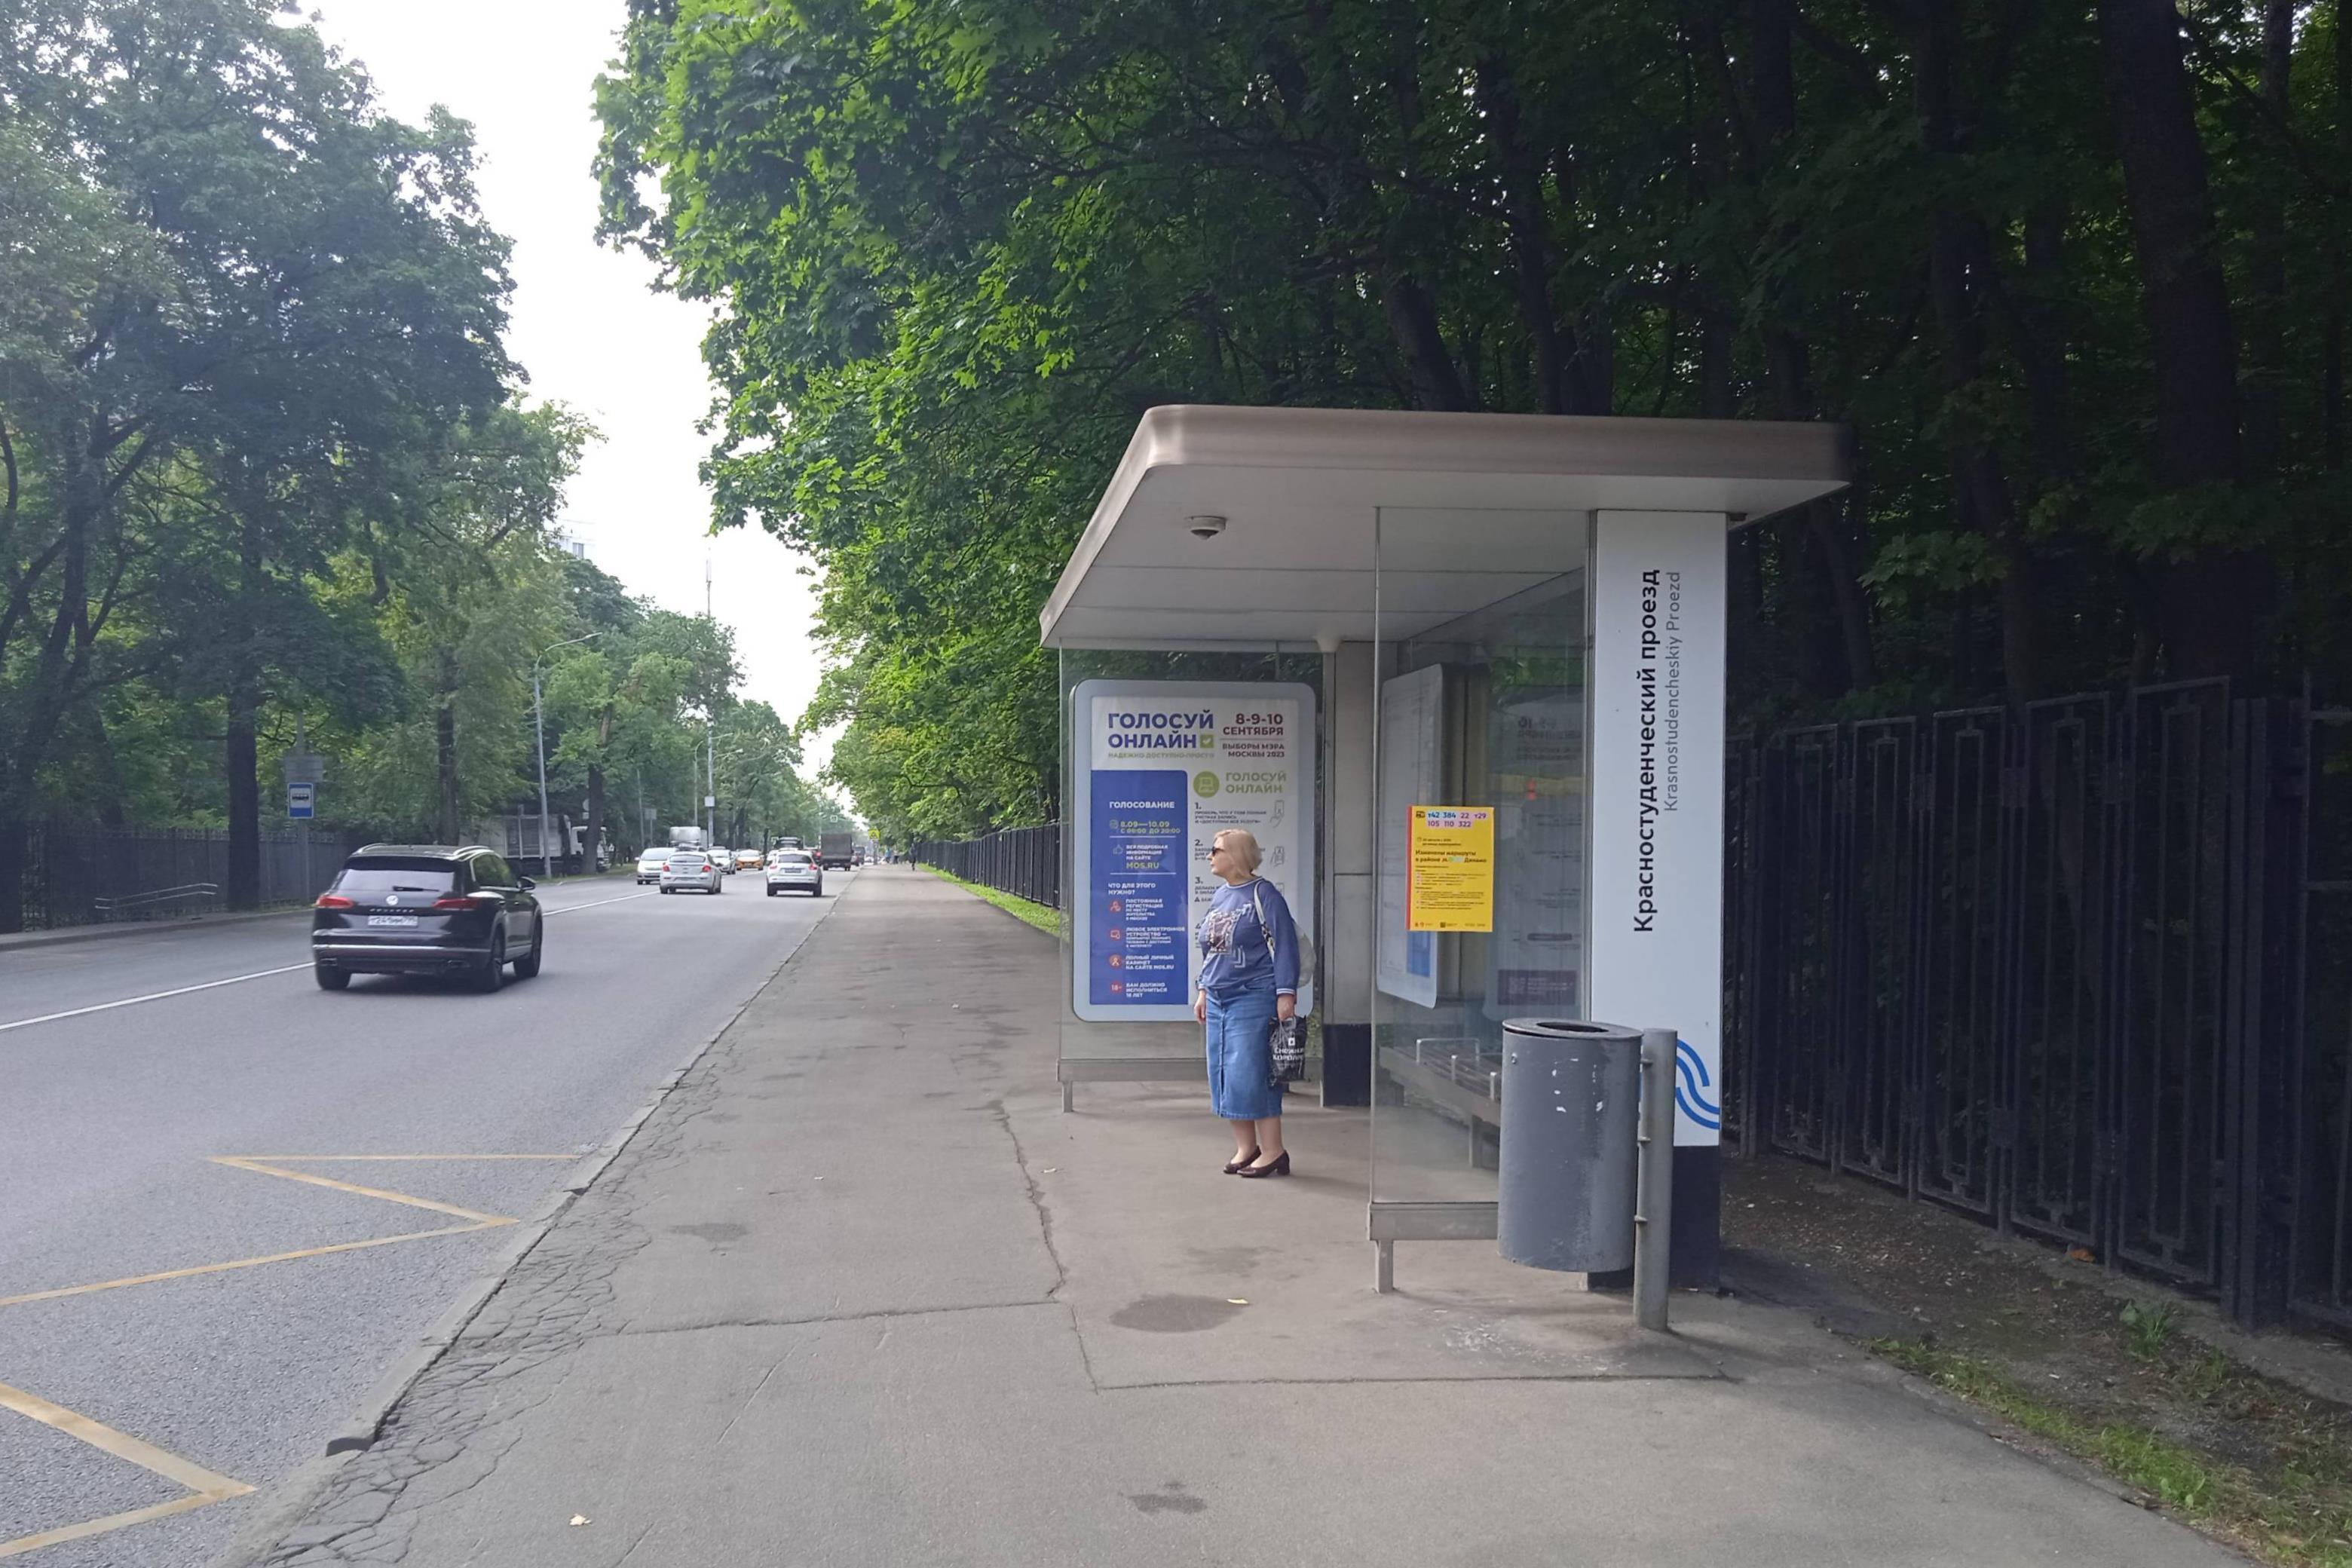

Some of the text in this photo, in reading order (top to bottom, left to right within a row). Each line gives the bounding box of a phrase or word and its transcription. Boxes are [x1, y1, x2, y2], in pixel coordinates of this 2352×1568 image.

[1664, 571, 1683, 811] Krasnostudencheskiy Proezd
[1108, 709, 1214, 729] ГОЛОСУЙ
[1236, 713, 1283, 724] 8-9-10
[1223, 727, 1283, 735] СЕНТЯБРЯ
[1108, 730, 1197, 749] ОНЛАЙН
[1634, 570, 1660, 933] Красностуденческий проезд
[1226, 770, 1287, 781] ГОЛОСУЙ
[1226, 782, 1283, 793] ОНЛАЙН
